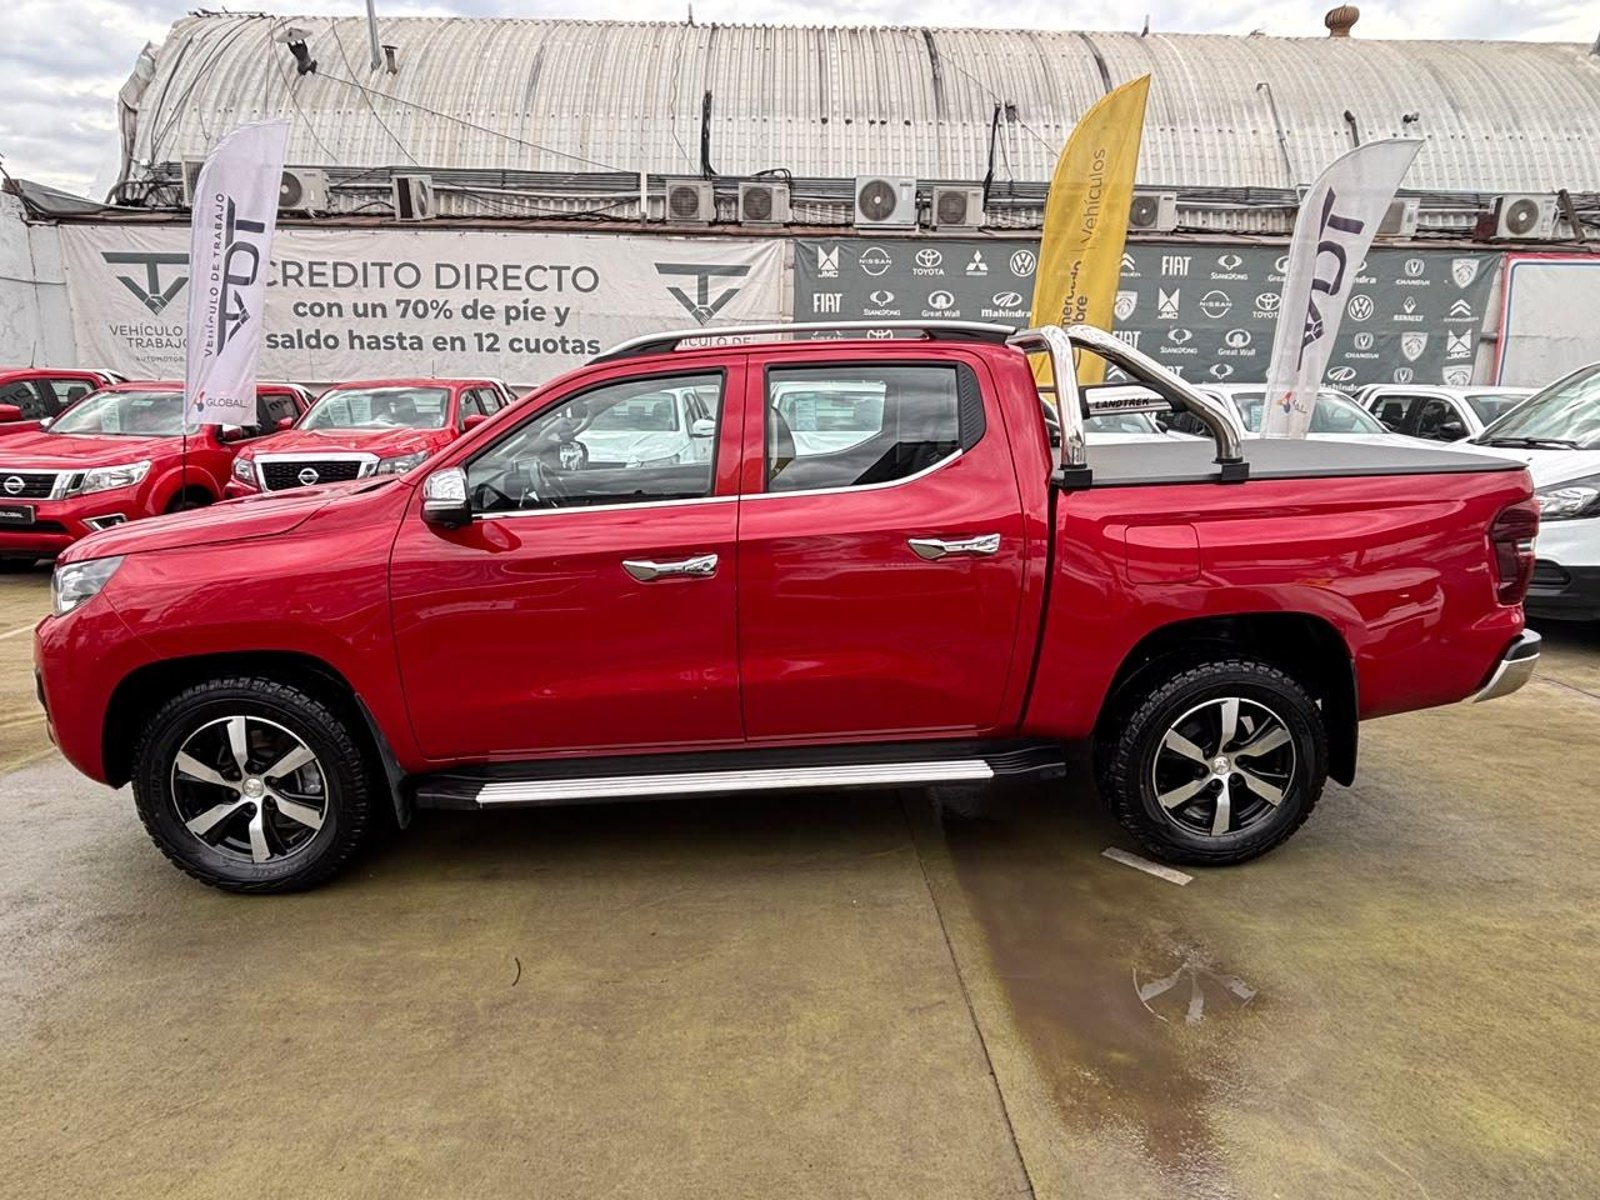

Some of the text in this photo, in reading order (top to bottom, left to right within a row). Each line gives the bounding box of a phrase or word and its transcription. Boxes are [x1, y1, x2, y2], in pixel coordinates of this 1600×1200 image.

[1080, 149, 1106, 244] Vehículos
[213, 193, 226, 261] TRABAJO
[211, 264, 221, 281] DE
[912, 268, 945, 276] TOYOTA
[1162, 255, 1192, 276] FIAT
[435, 263, 600, 293] DIRECTO
[813, 293, 843, 313] FIAT
[1072, 295, 1088, 326] bre
[293, 301, 343, 318] con
[353, 302, 388, 318] un
[395, 300, 453, 320] 70%
[461, 299, 496, 321] de
[553, 304, 571, 327] y
[921, 309, 942, 317] Great
[981, 309, 1033, 318] Mahindra
[1252, 311, 1279, 319] TOYOT
[109, 322, 184, 337] VEHÍCULO
[266, 330, 601, 356] saldo hasta en 12 cuotas
[206, 398, 248, 408] GLOBAL
[1095, 398, 1149, 409] LANDTREK
